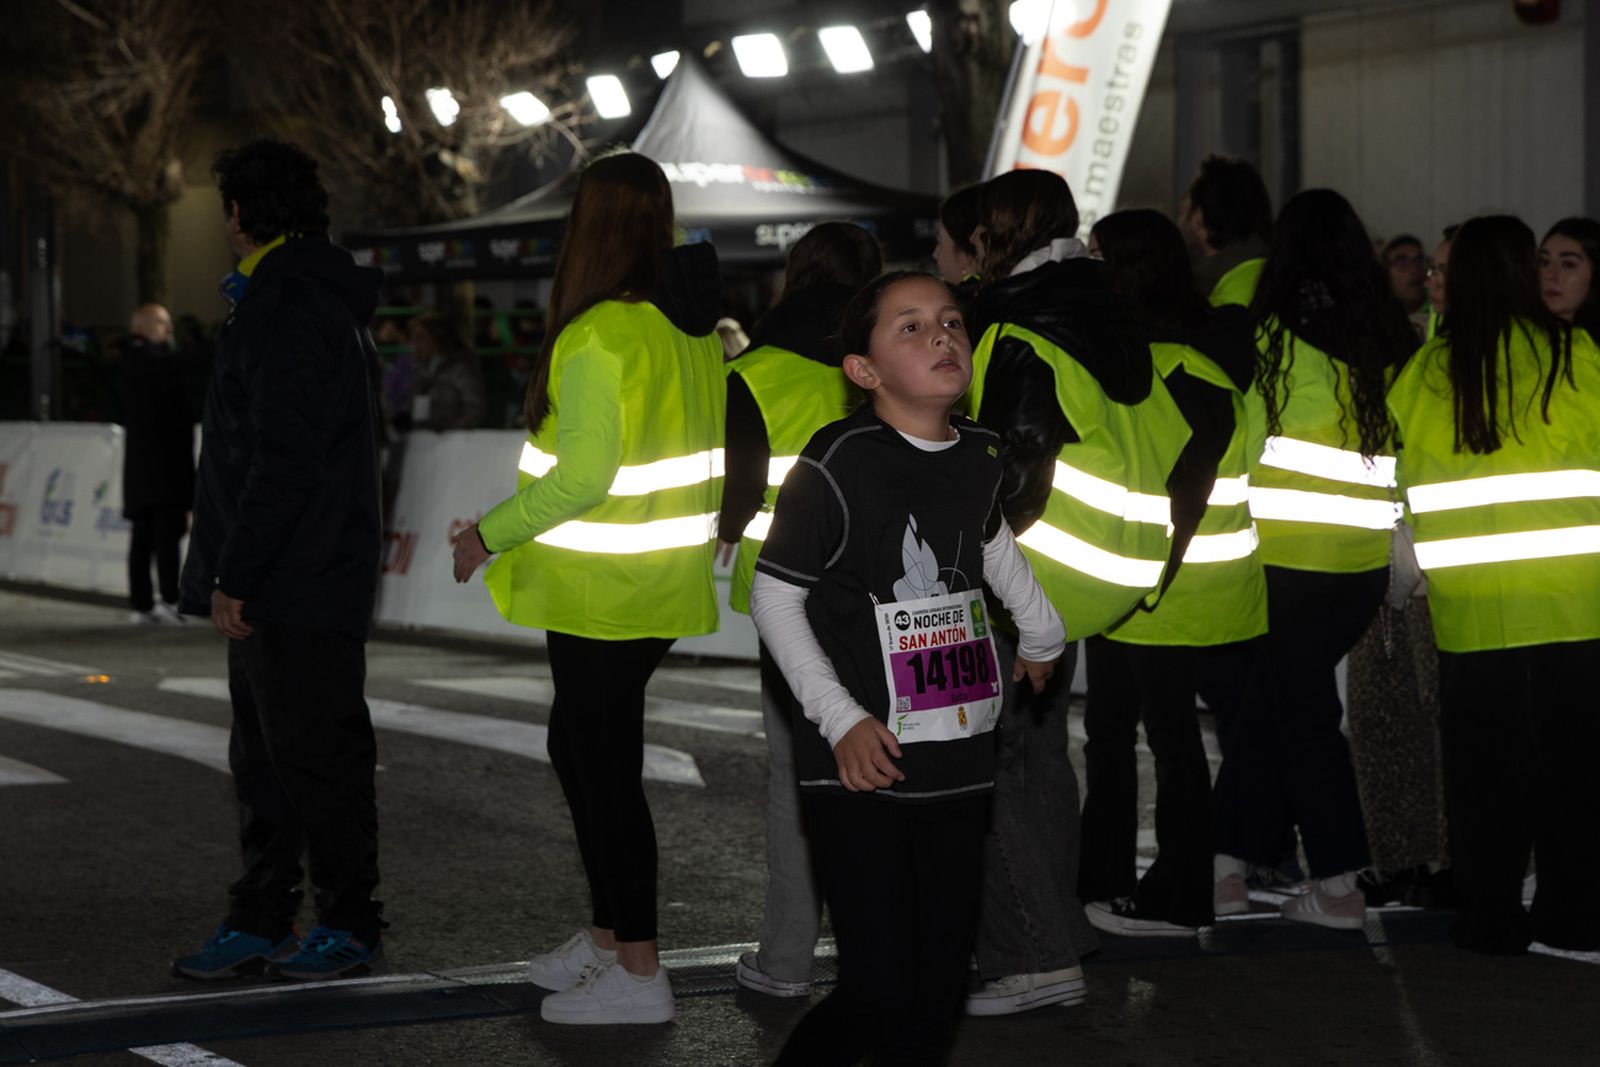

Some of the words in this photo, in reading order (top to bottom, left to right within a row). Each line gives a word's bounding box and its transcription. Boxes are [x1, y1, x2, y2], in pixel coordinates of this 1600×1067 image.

[1083, 20, 1143, 197] maestras
[895, 614, 909, 625] 43
[914, 613, 951, 629] NOCHE
[953, 610, 964, 623] DE
[899, 633, 927, 650] SAN
[931, 625, 966, 646] ANTÓN
[907, 642, 990, 694] 14198
